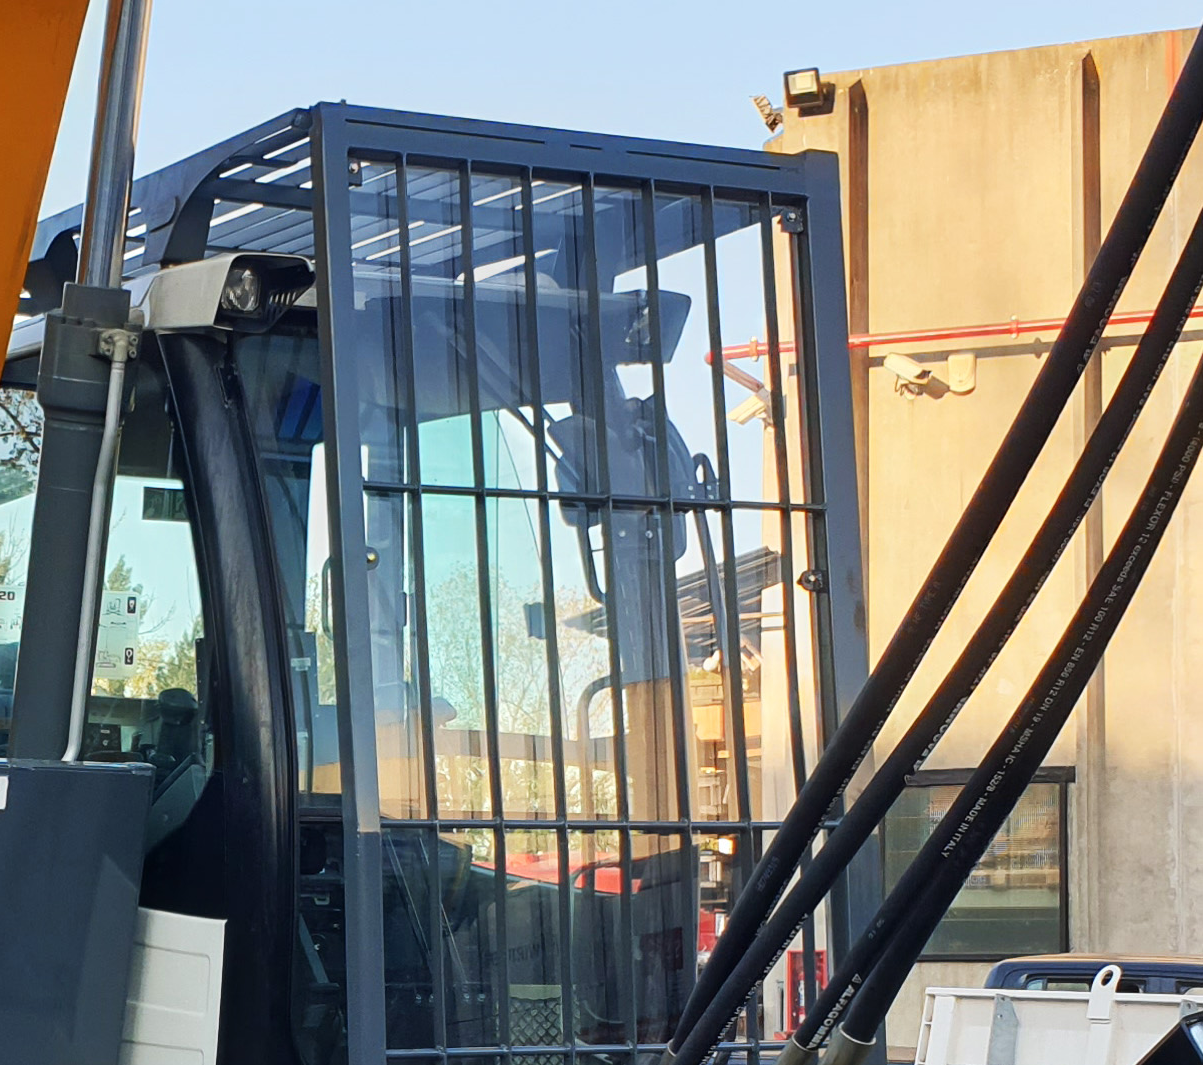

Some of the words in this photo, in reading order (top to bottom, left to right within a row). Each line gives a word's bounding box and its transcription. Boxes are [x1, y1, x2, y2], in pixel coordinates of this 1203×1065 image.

[1143, 488, 1173, 533] FLEXOR
[1136, 530, 1151, 545] 12
[1113, 542, 1145, 585] exceeds
[1102, 582, 1122, 606] SAE
[1092, 604, 1109, 624] 100
[1081, 621, 1099, 643] R12
[1069, 644, 1085, 663] EN
[1009, 725, 1034, 756] MSHA
[963, 794, 987, 825] MADE
[955, 820, 970, 835] IN
[938, 830, 963, 859] ITALY
[805, 984, 855, 1049] ALFAGOMMA
